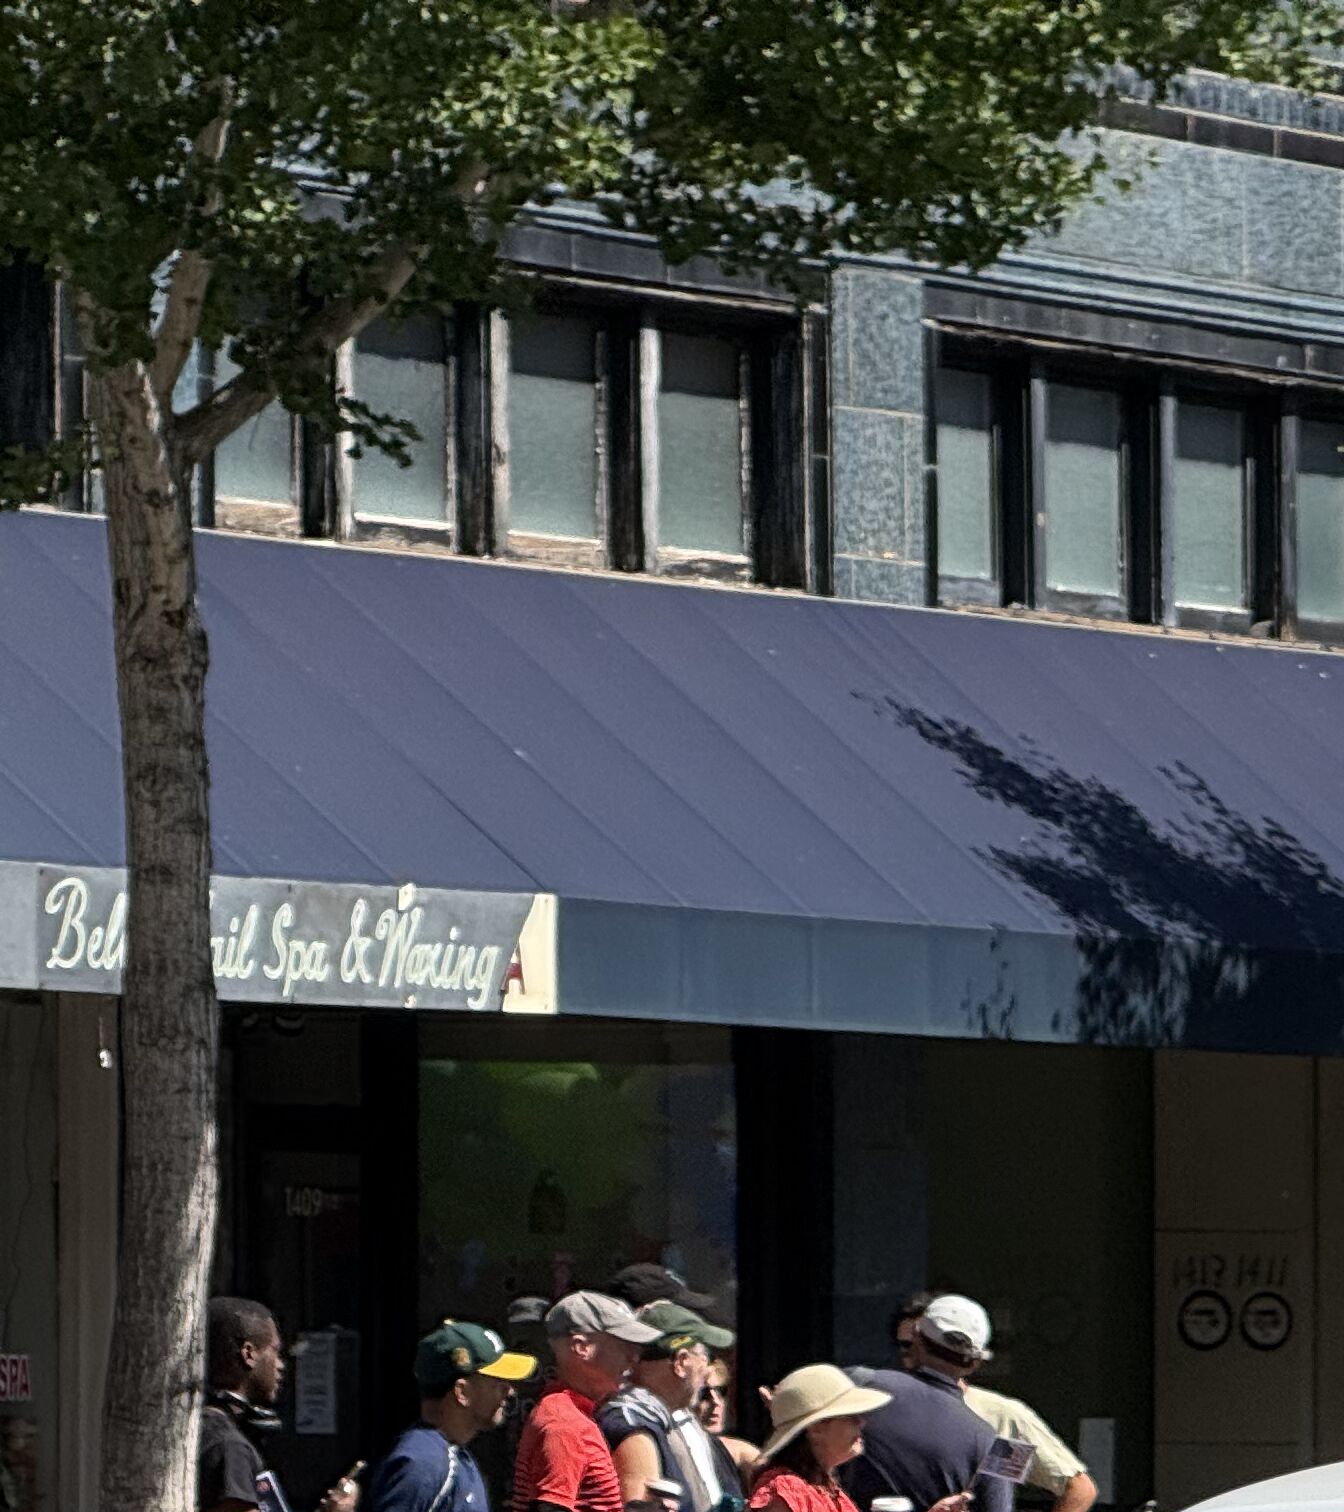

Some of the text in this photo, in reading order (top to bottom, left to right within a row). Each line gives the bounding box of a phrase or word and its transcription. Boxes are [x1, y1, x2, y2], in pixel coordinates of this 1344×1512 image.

[262, 902, 331, 997] Spa
[340, 898, 373, 984] &
[375, 906, 502, 1011] Waxing
[0, 1353, 32, 1401] SPA
